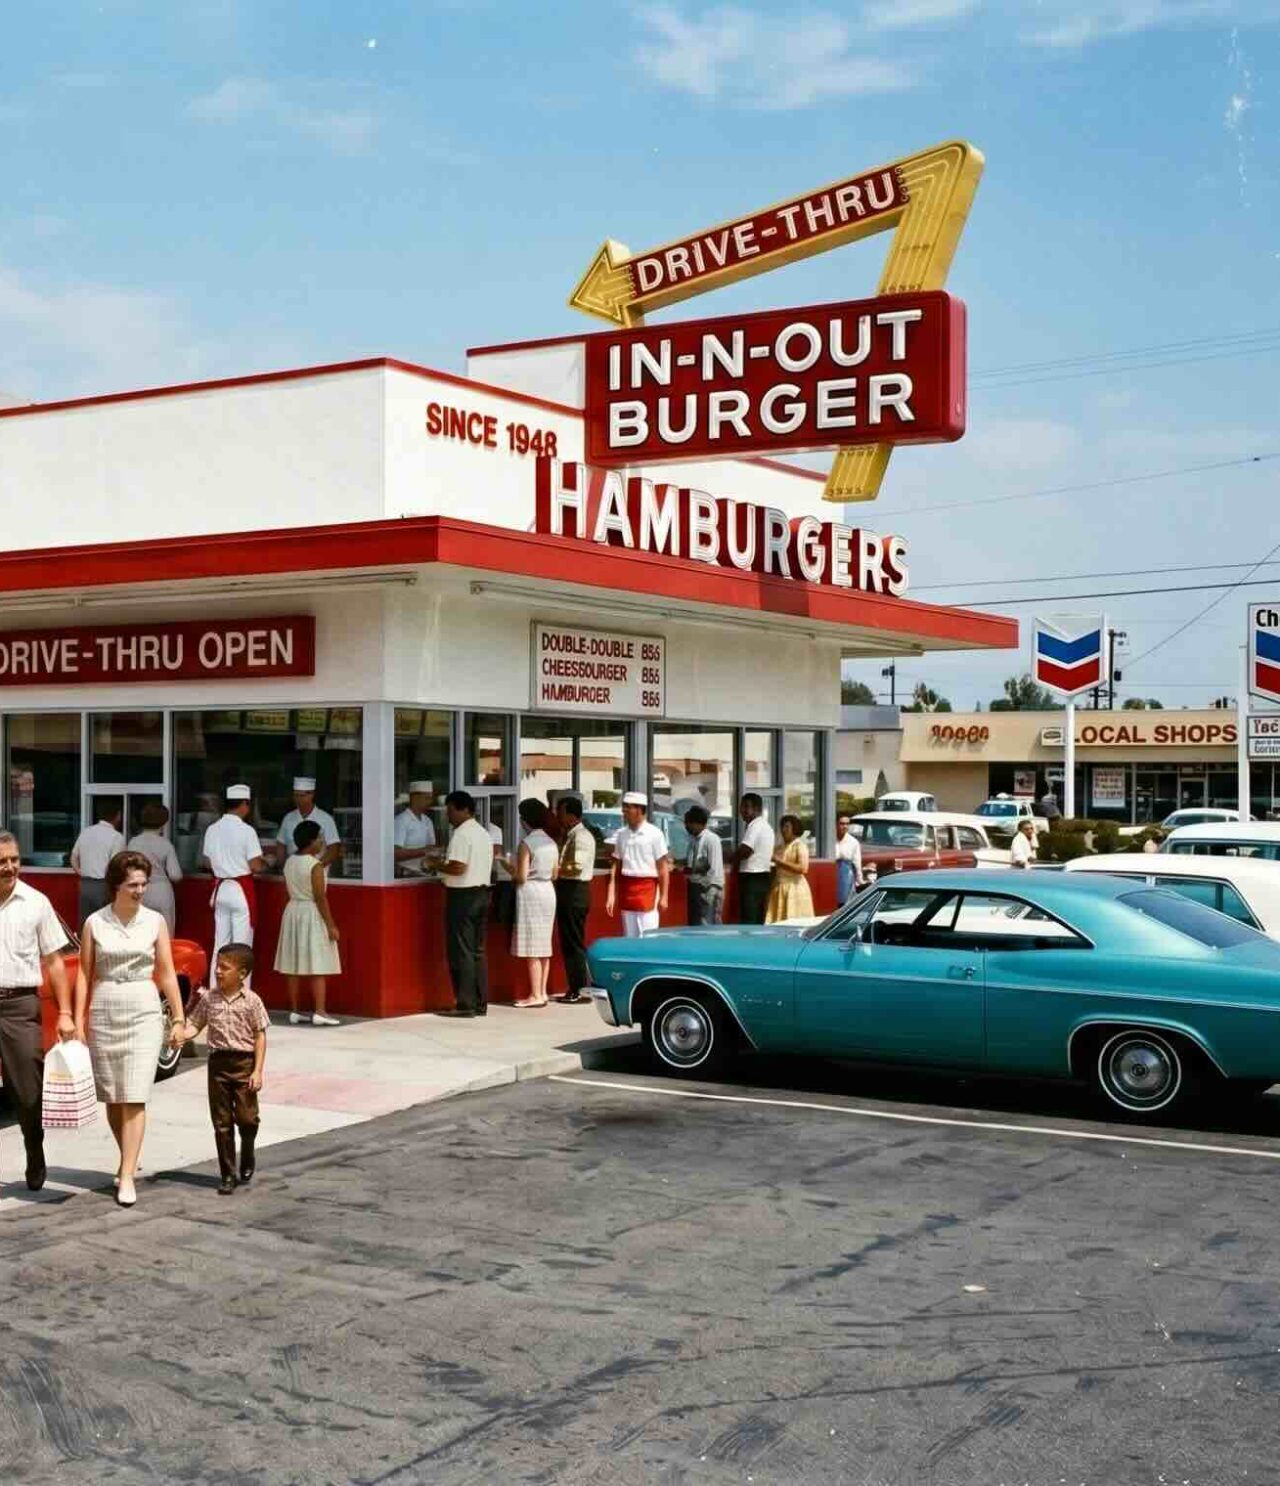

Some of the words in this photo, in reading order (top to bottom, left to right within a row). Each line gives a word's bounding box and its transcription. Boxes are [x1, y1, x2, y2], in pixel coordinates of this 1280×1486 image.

[637, 171, 897, 293] DRIVE-THRU
[609, 309, 923, 391] IN-N-OUT
[426, 402, 498, 448] SINCE
[506, 422, 558, 458] 1948
[609, 373, 916, 449] BURGER
[536, 456, 910, 598] HAMBURGERS
[198, 629, 293, 669] OPEN
[542, 632, 634, 659] DOUBLE-DOUBLE
[1074, 725, 1146, 744] OCAL
[1153, 724, 1238, 743] SHOPS
